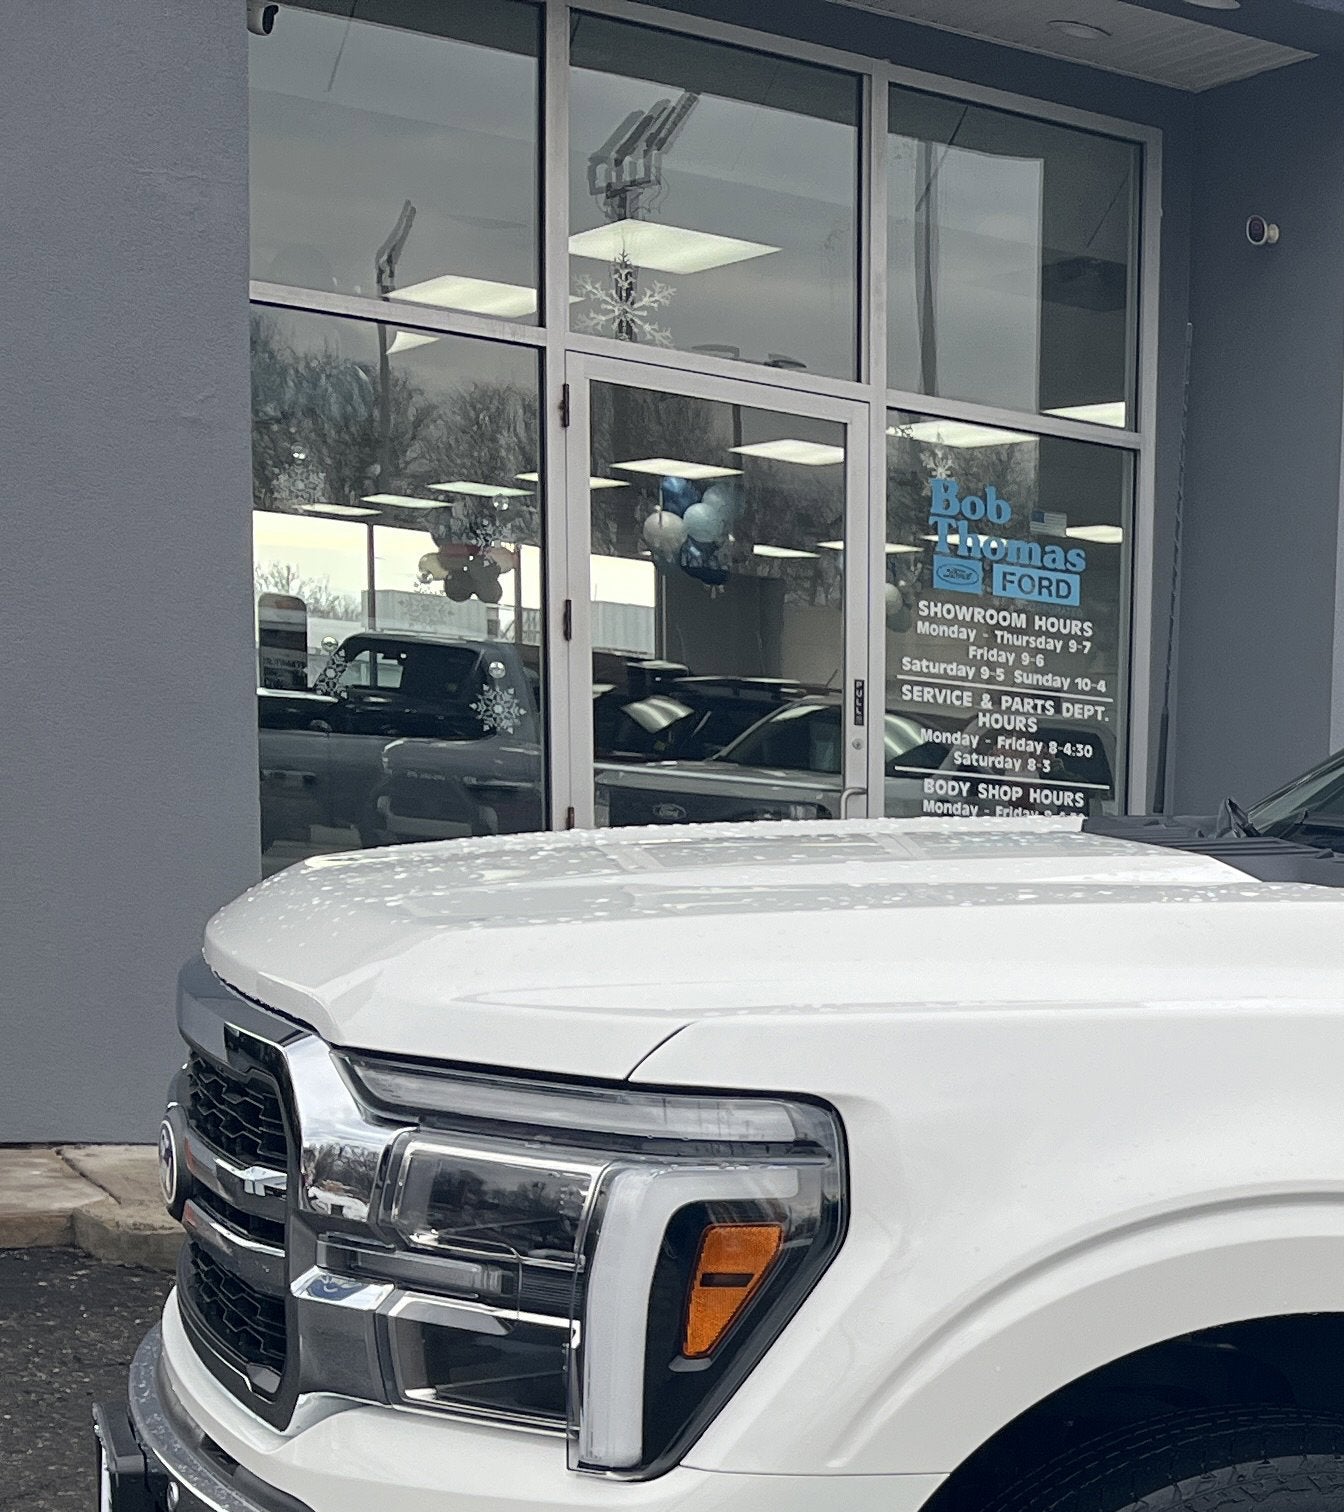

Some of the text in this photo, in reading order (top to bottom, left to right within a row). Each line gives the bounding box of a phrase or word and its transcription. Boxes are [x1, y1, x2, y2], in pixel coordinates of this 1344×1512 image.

[929, 478, 1012, 524] Bob
[928, 516, 1086, 573] Thomas
[1002, 571, 1072, 599] FORD
[918, 600, 1026, 629] SHOWROOM
[1034, 615, 1093, 637] HOURS
[917, 621, 976, 642] Monday
[995, 630, 1063, 652] Thursday
[1068, 641, 1092, 654] 9-7
[969, 646, 1045, 667] Friday 9-6
[902, 656, 1106, 693] Saturday 9-5 Sunday 10-4
[901, 685, 1109, 721] SERVICE & PARTS DEPT.
[978, 713, 1038, 733] HOURS
[921, 728, 979, 748] Monday
[997, 736, 1043, 755] Friday
[1048, 742, 1093, 758] 8-4:30
[953, 751, 1021, 772] Saturday
[924, 778, 1085, 808] BODY SHOP HOURS
[923, 799, 978, 818] Monday
